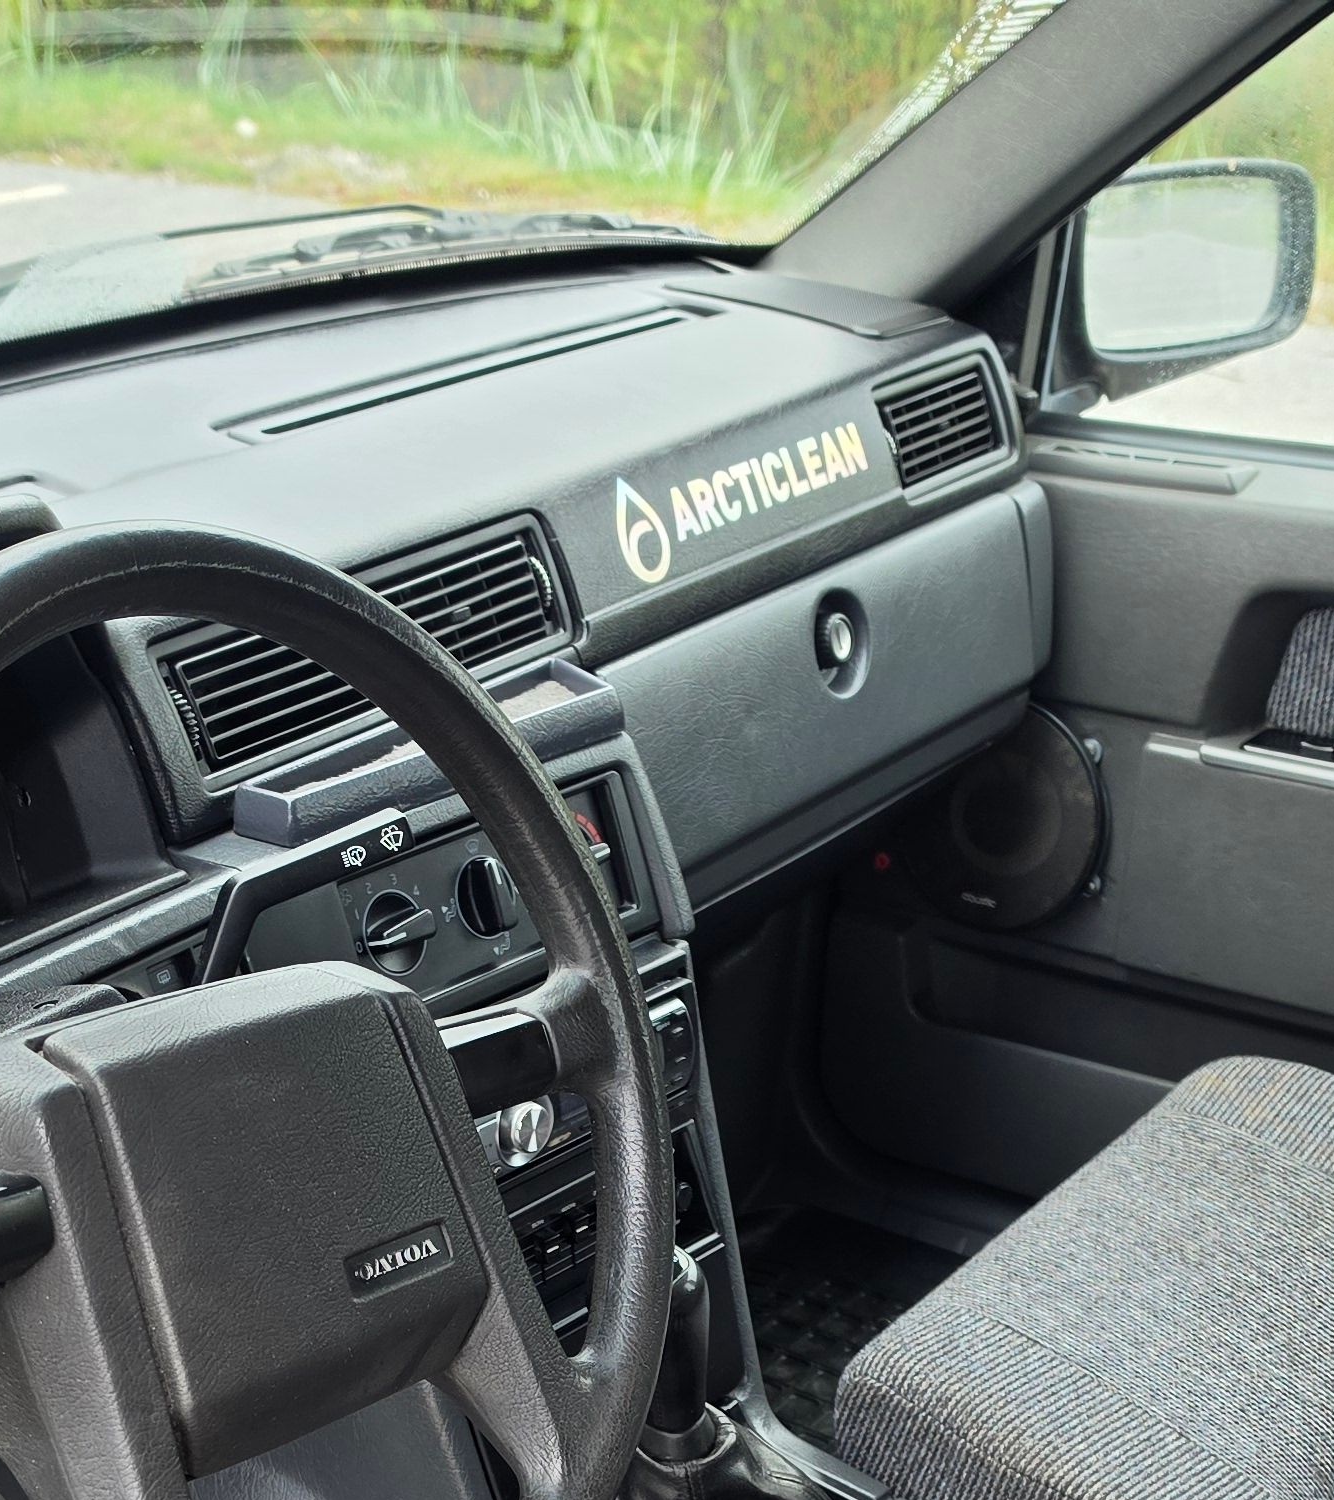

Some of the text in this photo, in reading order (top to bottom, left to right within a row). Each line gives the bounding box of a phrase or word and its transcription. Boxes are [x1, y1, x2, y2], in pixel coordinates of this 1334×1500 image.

[669, 421, 869, 543] ARCTICLEAN
[390, 874, 397, 885] 3
[365, 882, 372, 894] 2
[413, 885, 420, 895] 4
[356, 942, 363, 954] 0
[359, 1238, 441, 1281] VOLVO
